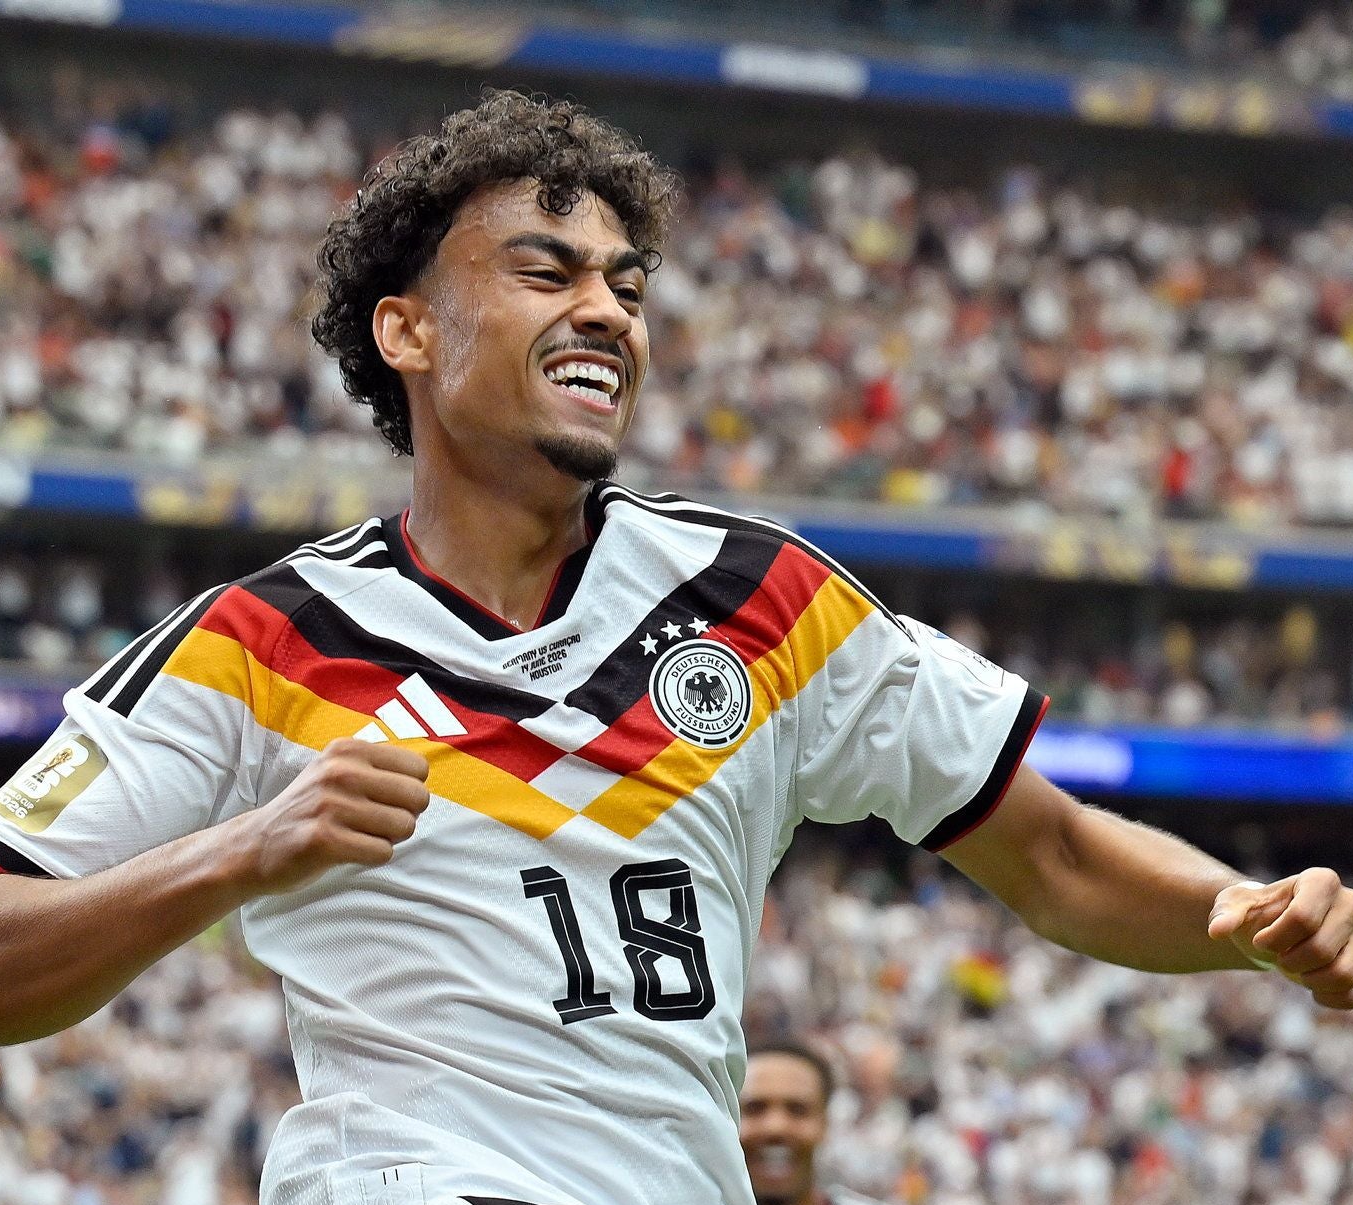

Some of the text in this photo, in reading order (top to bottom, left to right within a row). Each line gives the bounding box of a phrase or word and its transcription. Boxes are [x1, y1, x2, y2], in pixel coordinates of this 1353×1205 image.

[547, 649, 567, 663] 2026
[529, 662, 563, 681] HOUSTON
[671, 656, 727, 678] DEUTSCHER
[675, 701, 740, 731] FUSSBALL-BUND
[20, 797, 35, 810] CUP
[519, 858, 716, 1025] 18
